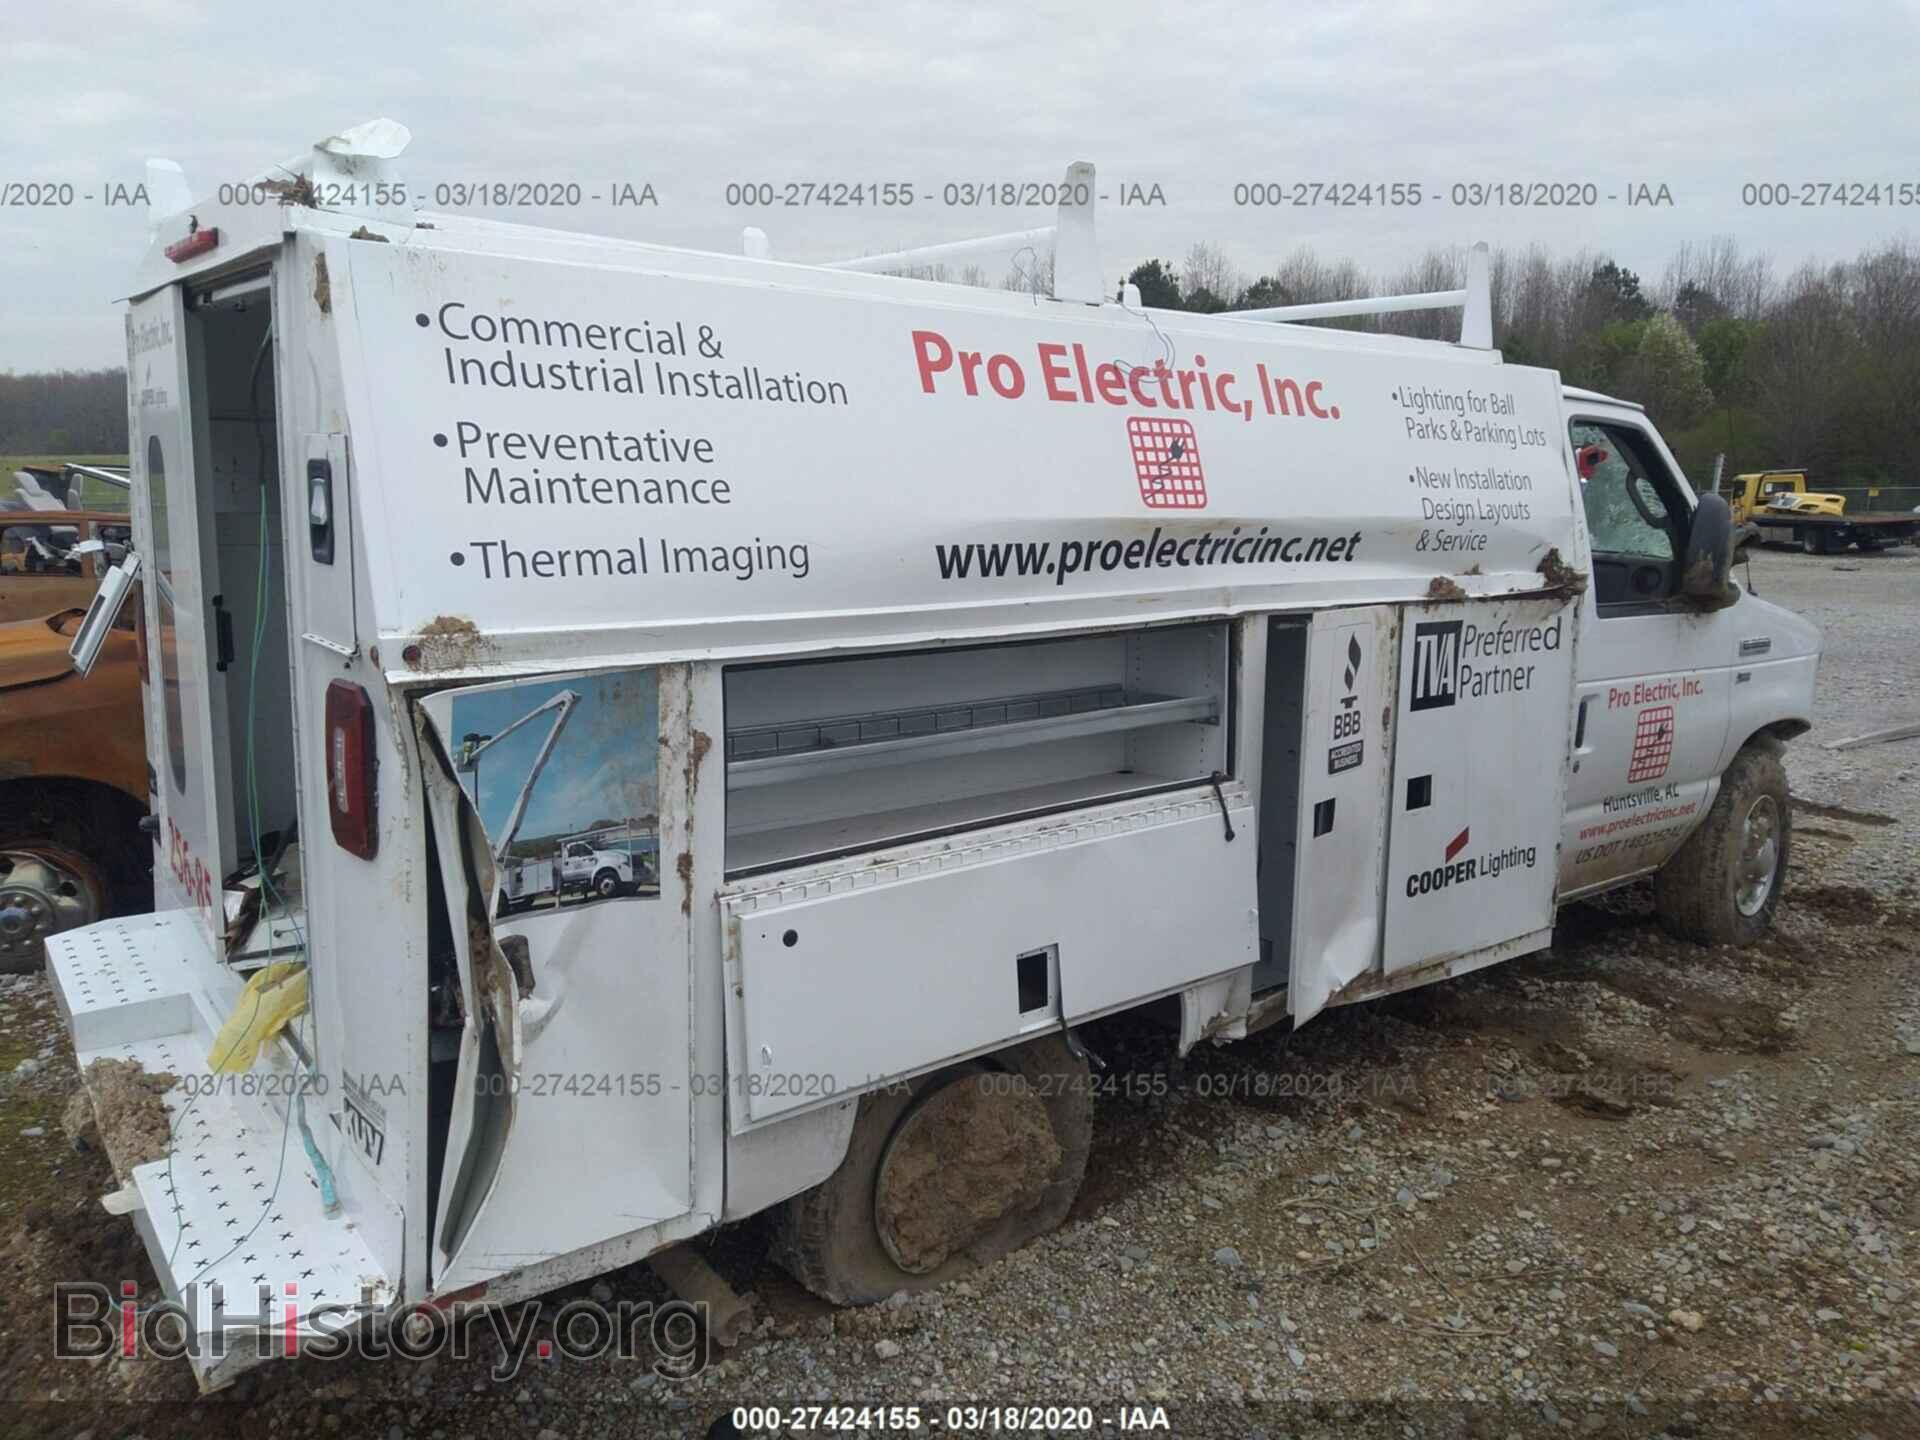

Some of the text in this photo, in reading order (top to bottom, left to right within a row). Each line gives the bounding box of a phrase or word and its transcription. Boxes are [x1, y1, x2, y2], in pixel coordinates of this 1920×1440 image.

[438, 302, 724, 359] Commercial &
[444, 347, 849, 406] Industrial Installation
[911, 330, 1341, 422] Pro Electric, Inc.
[1399, 385, 1515, 417] Lighting for Ball
[456, 421, 715, 463] Preventative
[1405, 417, 1546, 450] Parks & Parking Lots
[464, 467, 732, 505] Maintenance
[1416, 466, 1532, 490] New Installation
[1422, 497, 1531, 527] Design Layouts
[470, 536, 811, 581] Thermal Imaging
[935, 526, 1362, 586] www.proelectricinc.net
[1416, 529, 1488, 552] & Service
[1462, 616, 1562, 659] Preferred
[1416, 632, 1456, 699] TVA
[1459, 664, 1536, 699] Partner
[1608, 676, 1704, 709] Pro Electric, Inc.
[1334, 710, 1361, 740] BBB
[1406, 845, 1536, 897] COOPER Lighting
